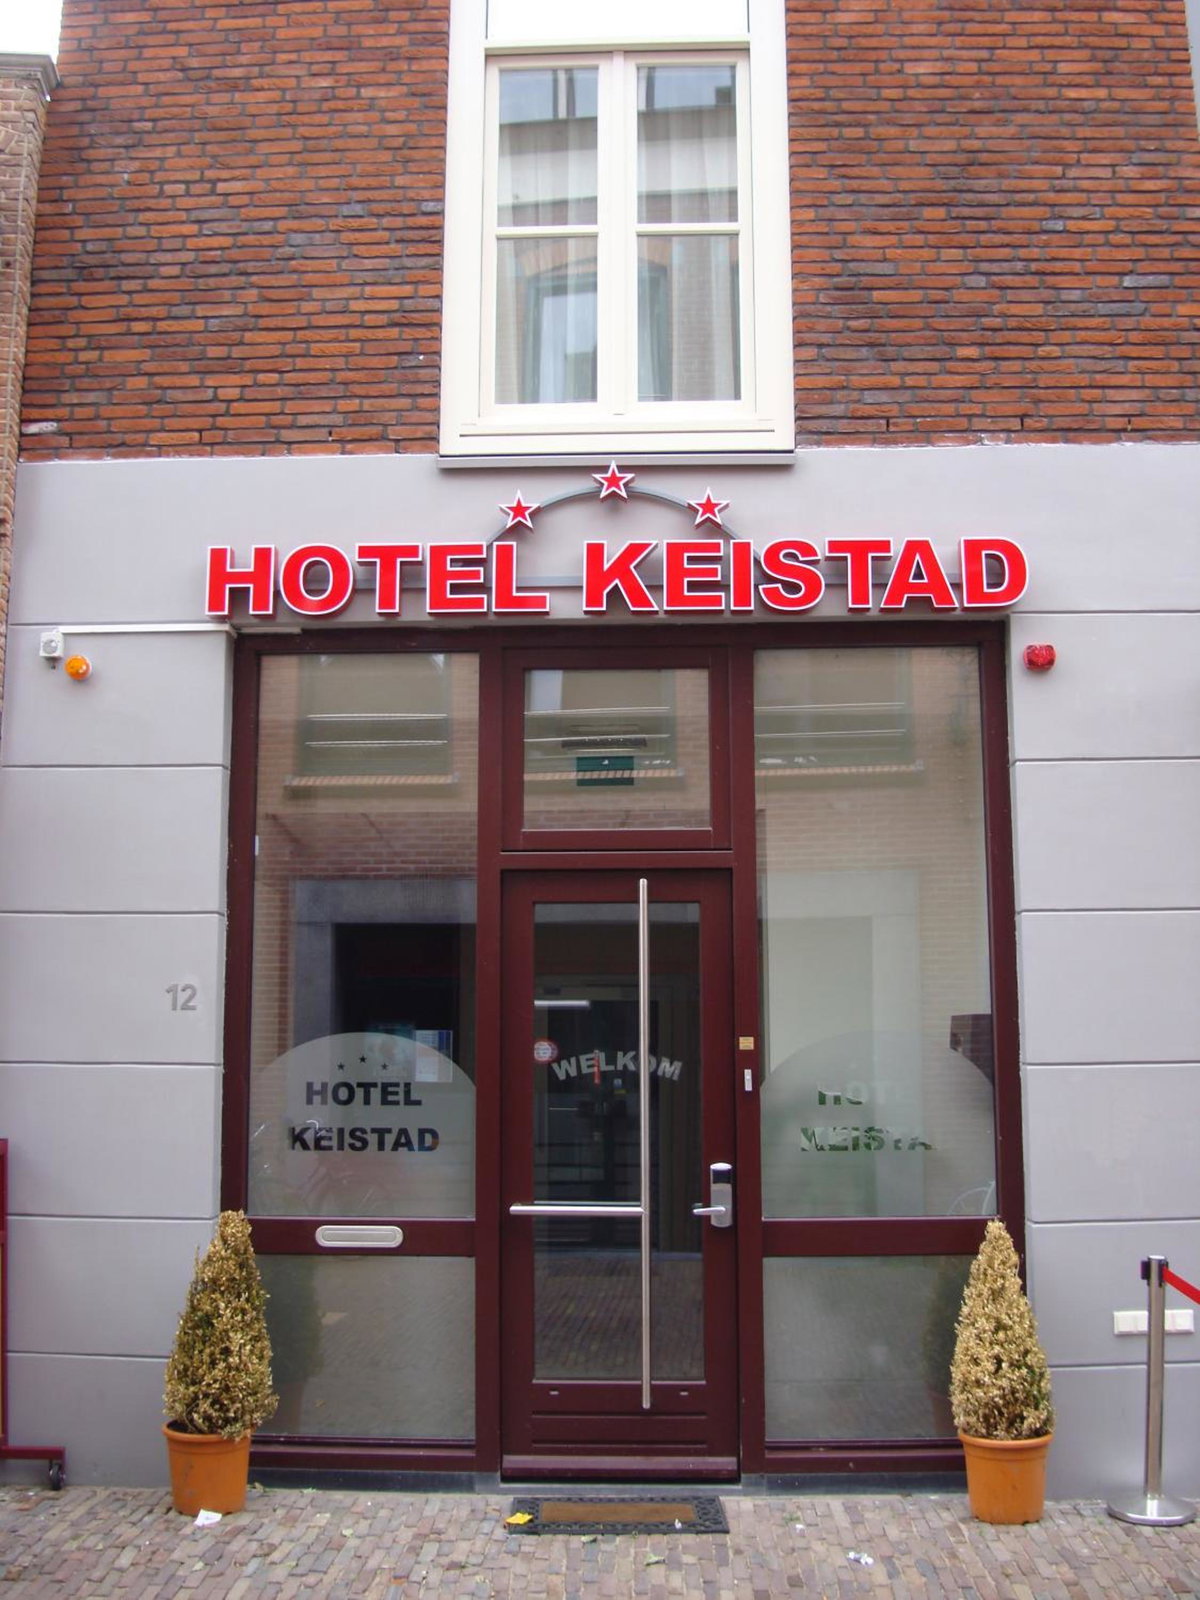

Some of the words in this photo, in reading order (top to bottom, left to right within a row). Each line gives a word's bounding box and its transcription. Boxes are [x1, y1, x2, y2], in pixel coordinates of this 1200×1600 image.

[205, 541, 551, 616] HOTEL
[582, 537, 1029, 613] KEISTAD
[165, 983, 198, 1011] 12
[305, 1081, 423, 1106] HOTEL
[290, 1126, 440, 1152] KEISTAD
